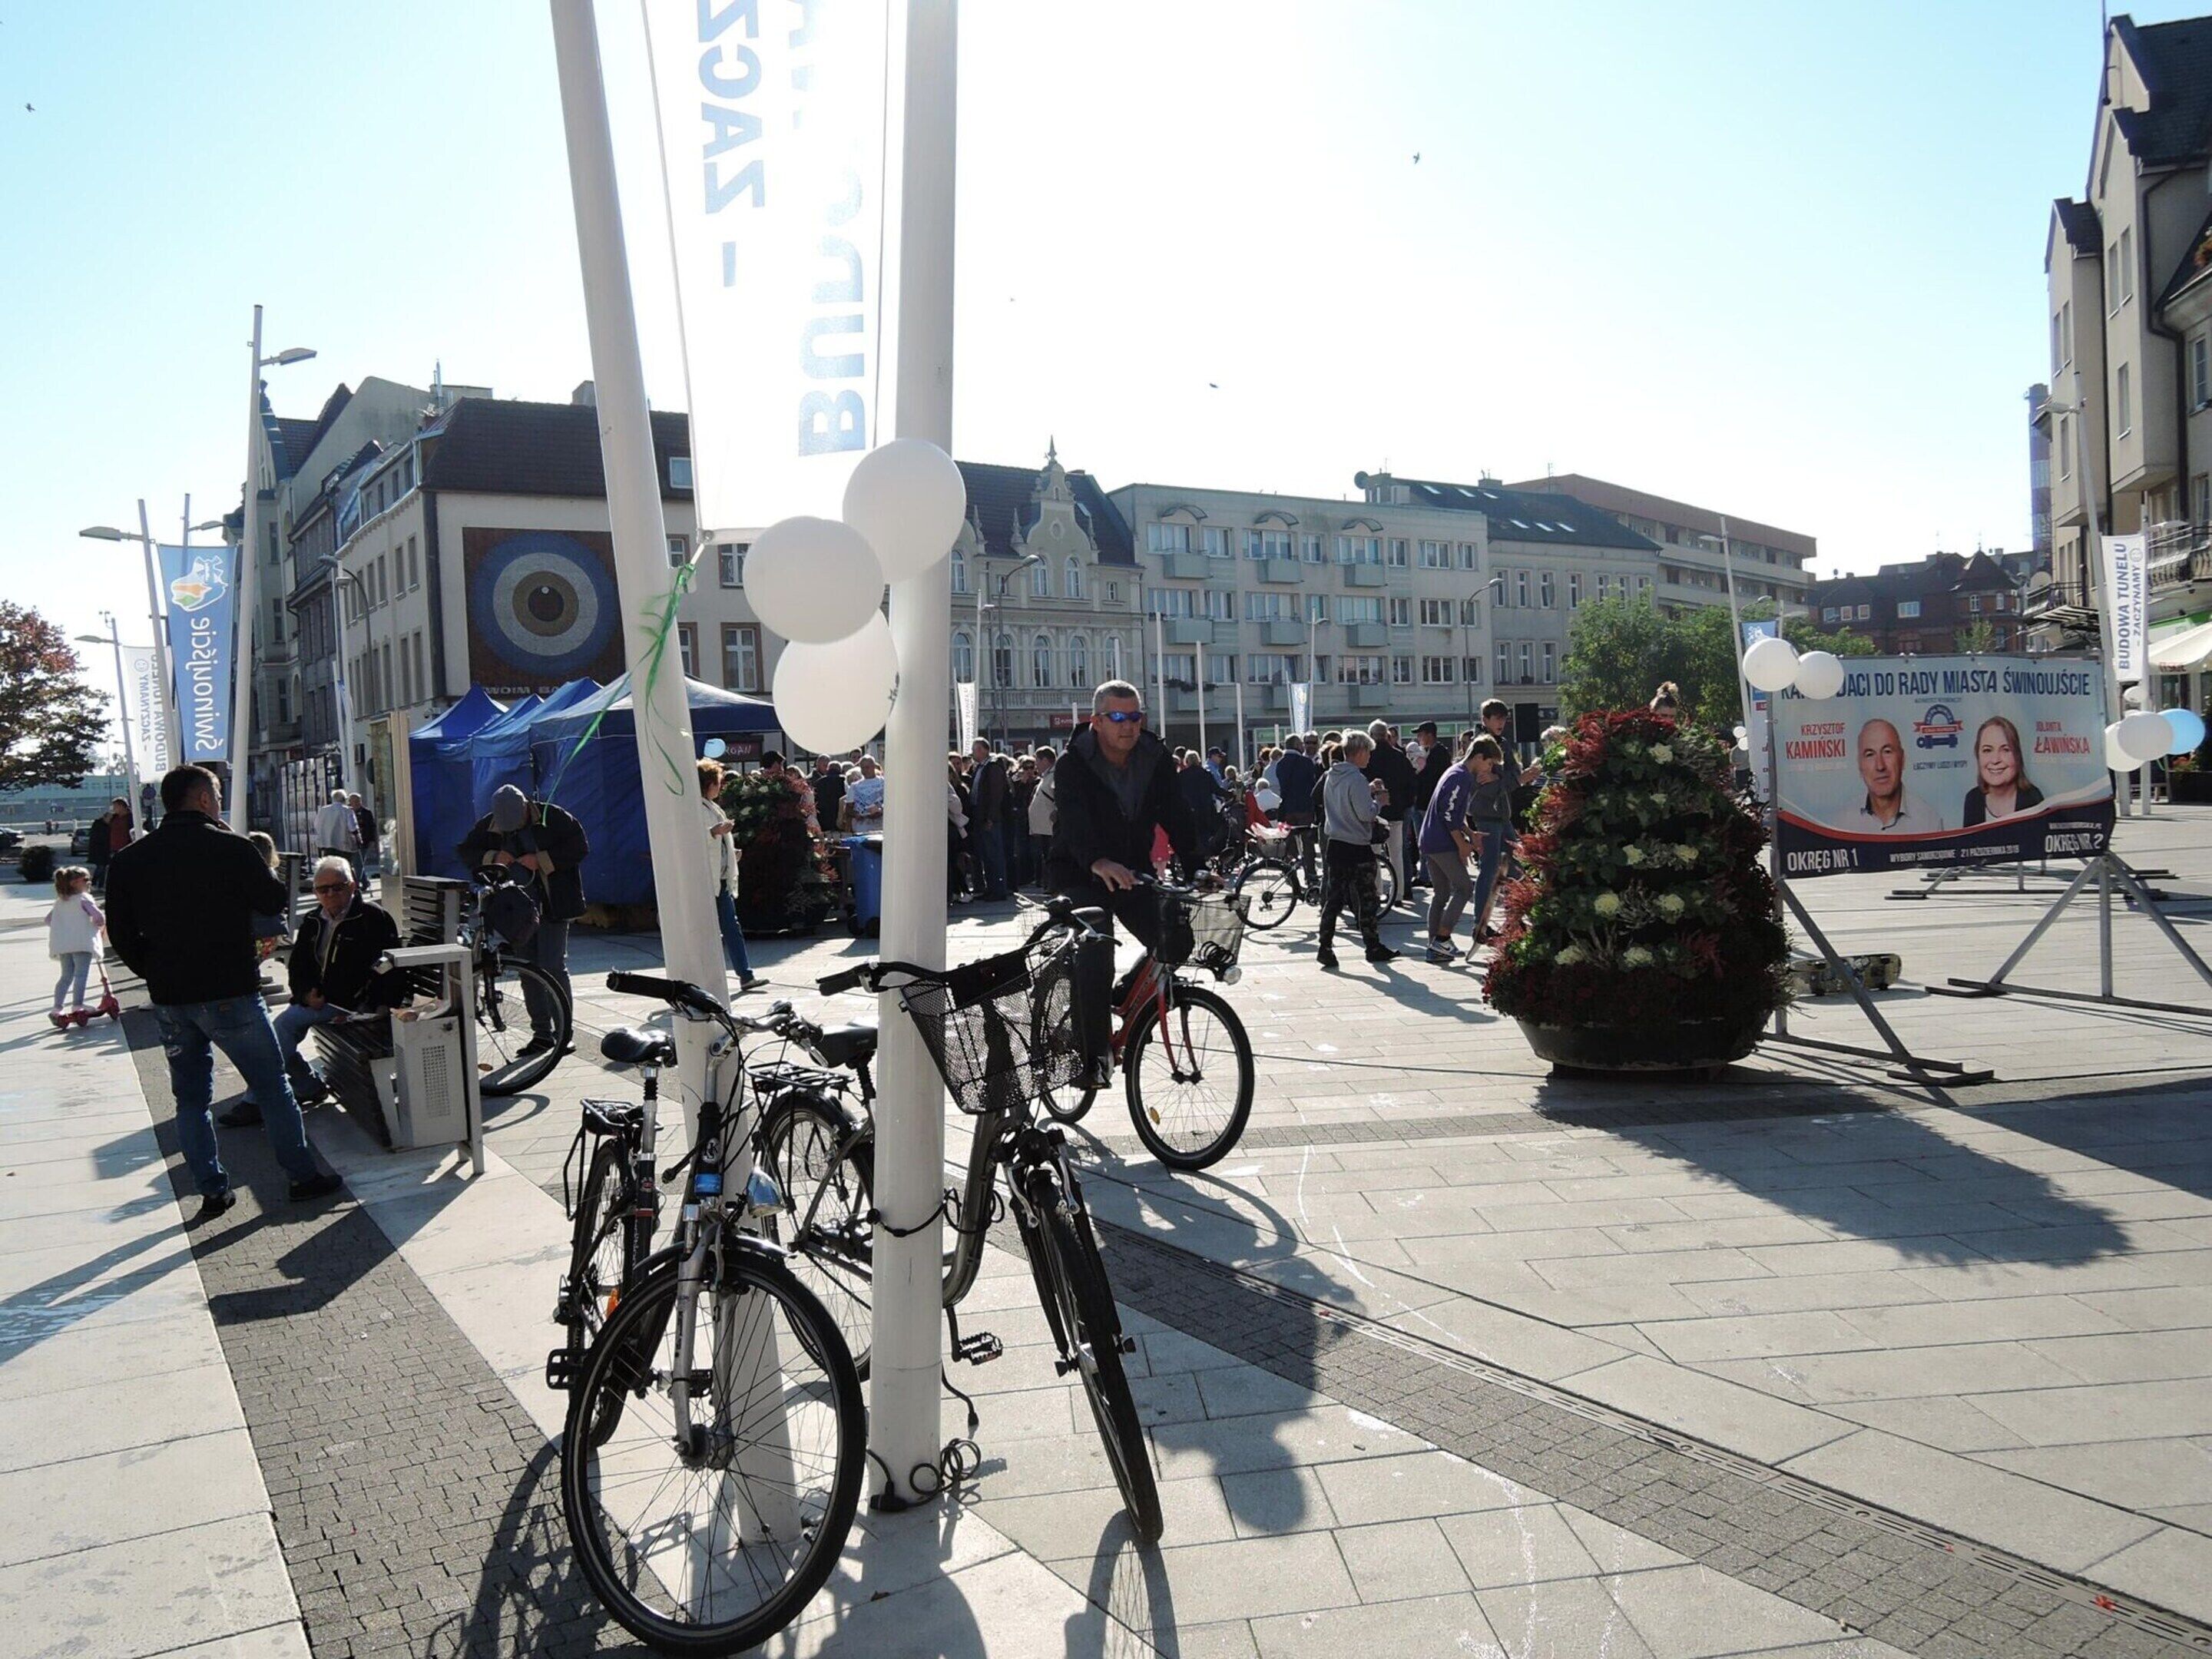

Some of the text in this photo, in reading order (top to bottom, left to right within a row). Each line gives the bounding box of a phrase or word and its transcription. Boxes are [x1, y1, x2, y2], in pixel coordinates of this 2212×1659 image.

[2114, 543, 2131, 670] BUDOWA TUNELU
[2131, 565, 2141, 637] ZACZYNAMY
[1875, 672, 1894, 695] DO
[1899, 671, 1938, 695] RADY
[1943, 670, 1997, 693] MIASTA
[2003, 666, 2091, 695] ŚWINOUJŚCIE
[1800, 723, 1846, 736] KRZYSZTOF
[1786, 737, 1846, 760] KAMIŃSKI
[2093, 833, 2104, 849] 2
[1787, 848, 1859, 873] OKRĘG NR 1
